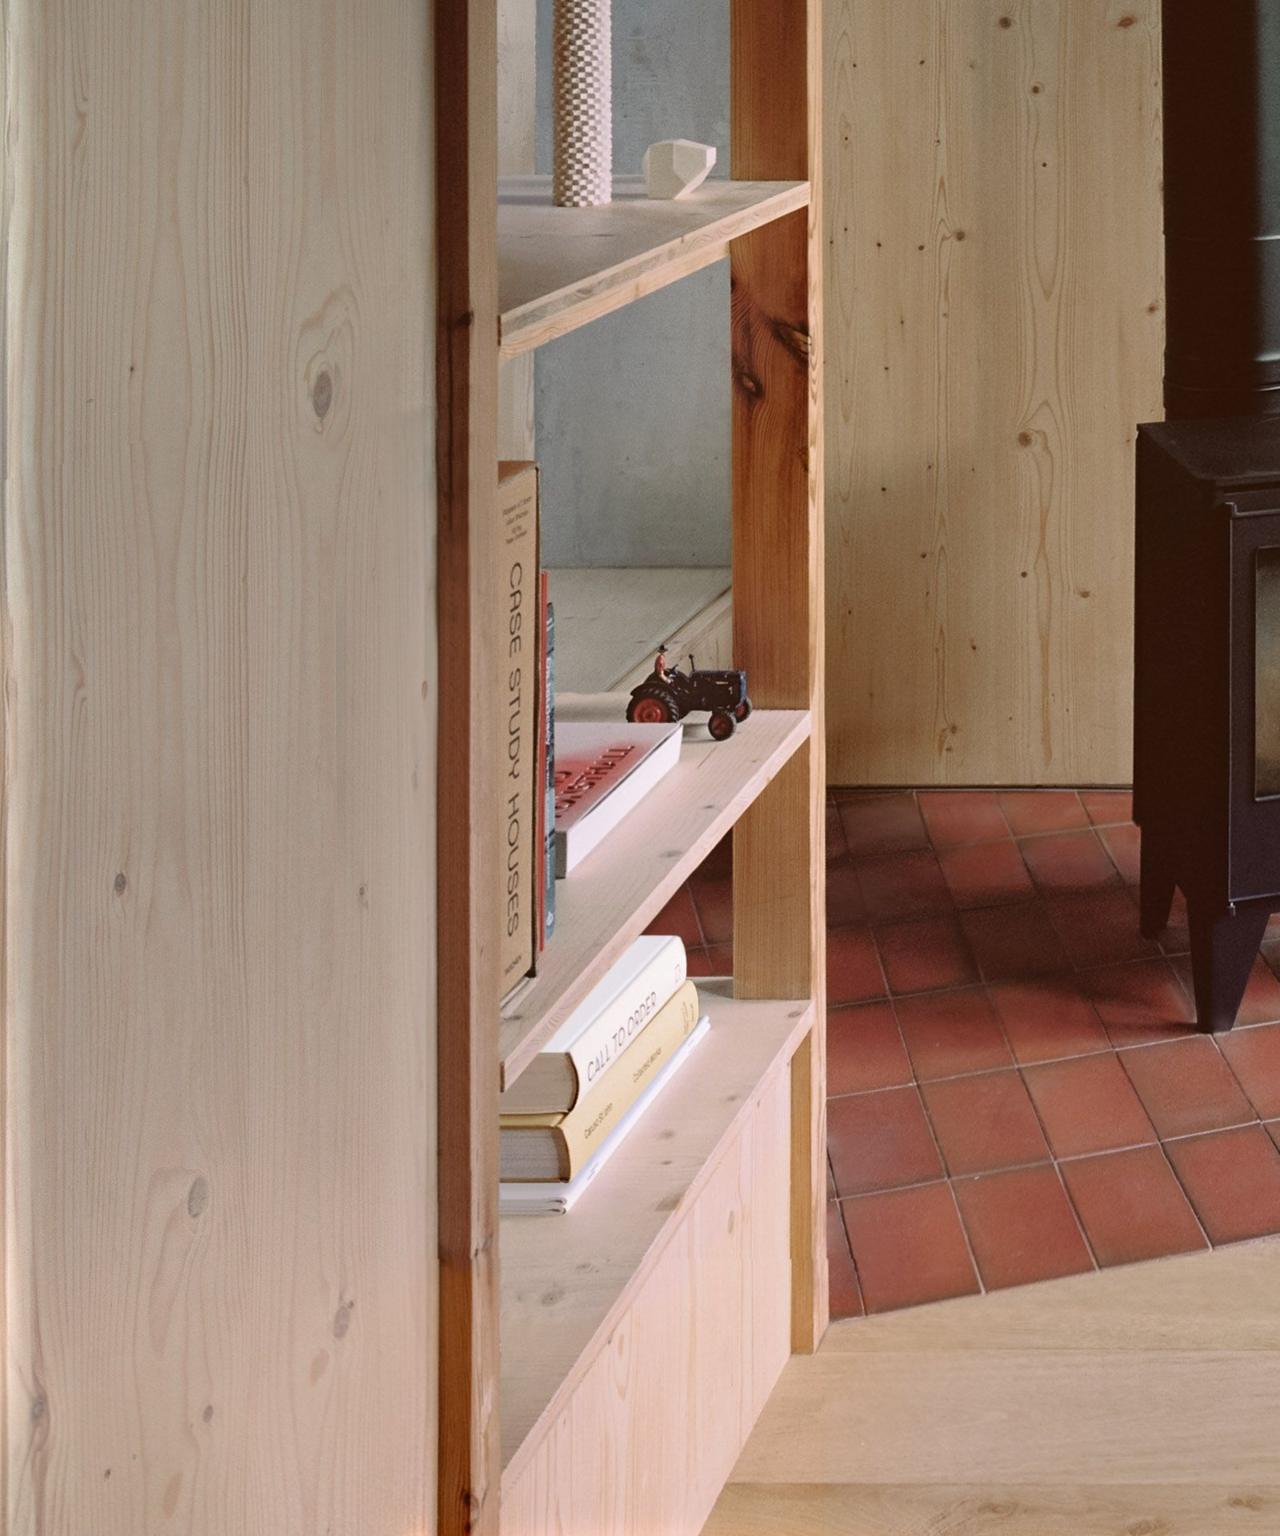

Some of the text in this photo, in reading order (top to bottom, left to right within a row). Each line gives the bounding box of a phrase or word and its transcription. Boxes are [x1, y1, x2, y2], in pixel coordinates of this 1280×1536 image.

[508, 562, 523, 658] CASE
[507, 667, 522, 780] STUDY
[506, 792, 521, 937] HOUSES
[587, 1043, 611, 1082] CALL
[612, 1026, 626, 1053] TO
[627, 991, 657, 1036] ORDER
